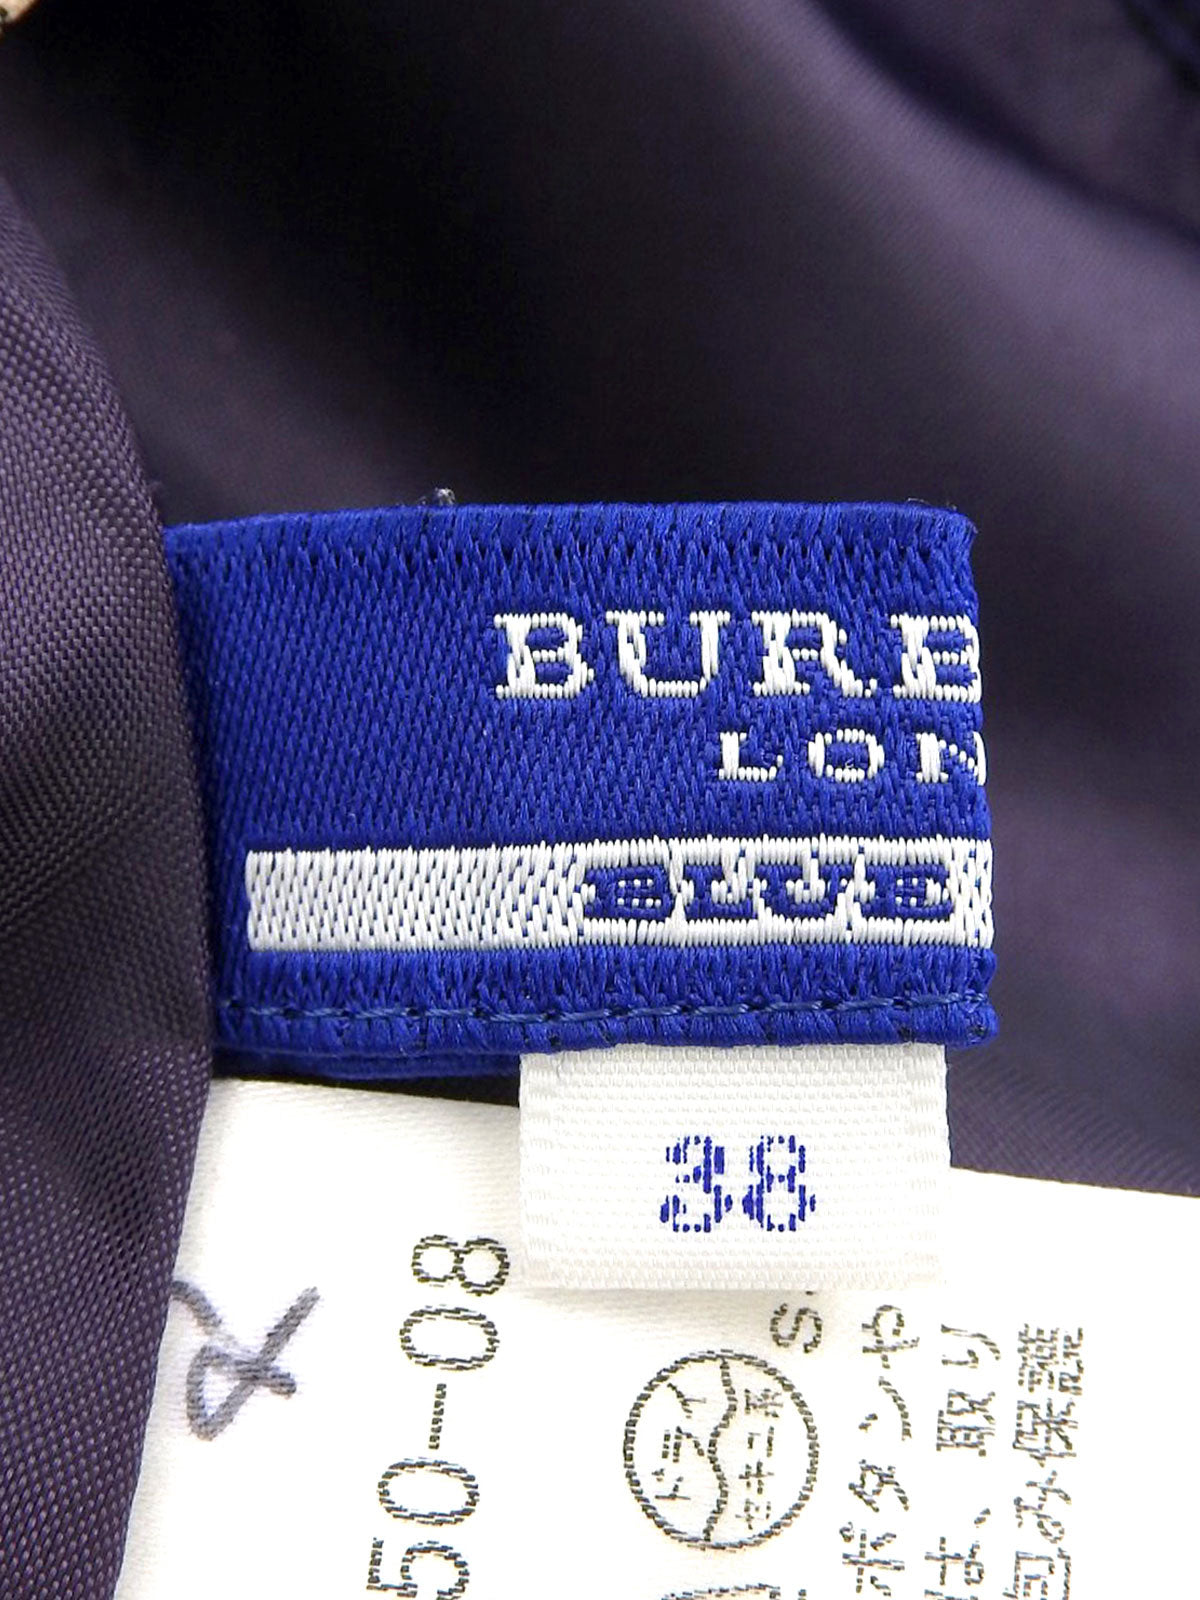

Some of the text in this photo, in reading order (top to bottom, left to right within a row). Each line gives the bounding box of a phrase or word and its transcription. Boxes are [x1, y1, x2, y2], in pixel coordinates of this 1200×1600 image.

[494, 610, 982, 702] BURB
[718, 728, 987, 786] LON
[660, 1135, 817, 1233] 38
[839, 1304, 921, 1597] ボタンや
